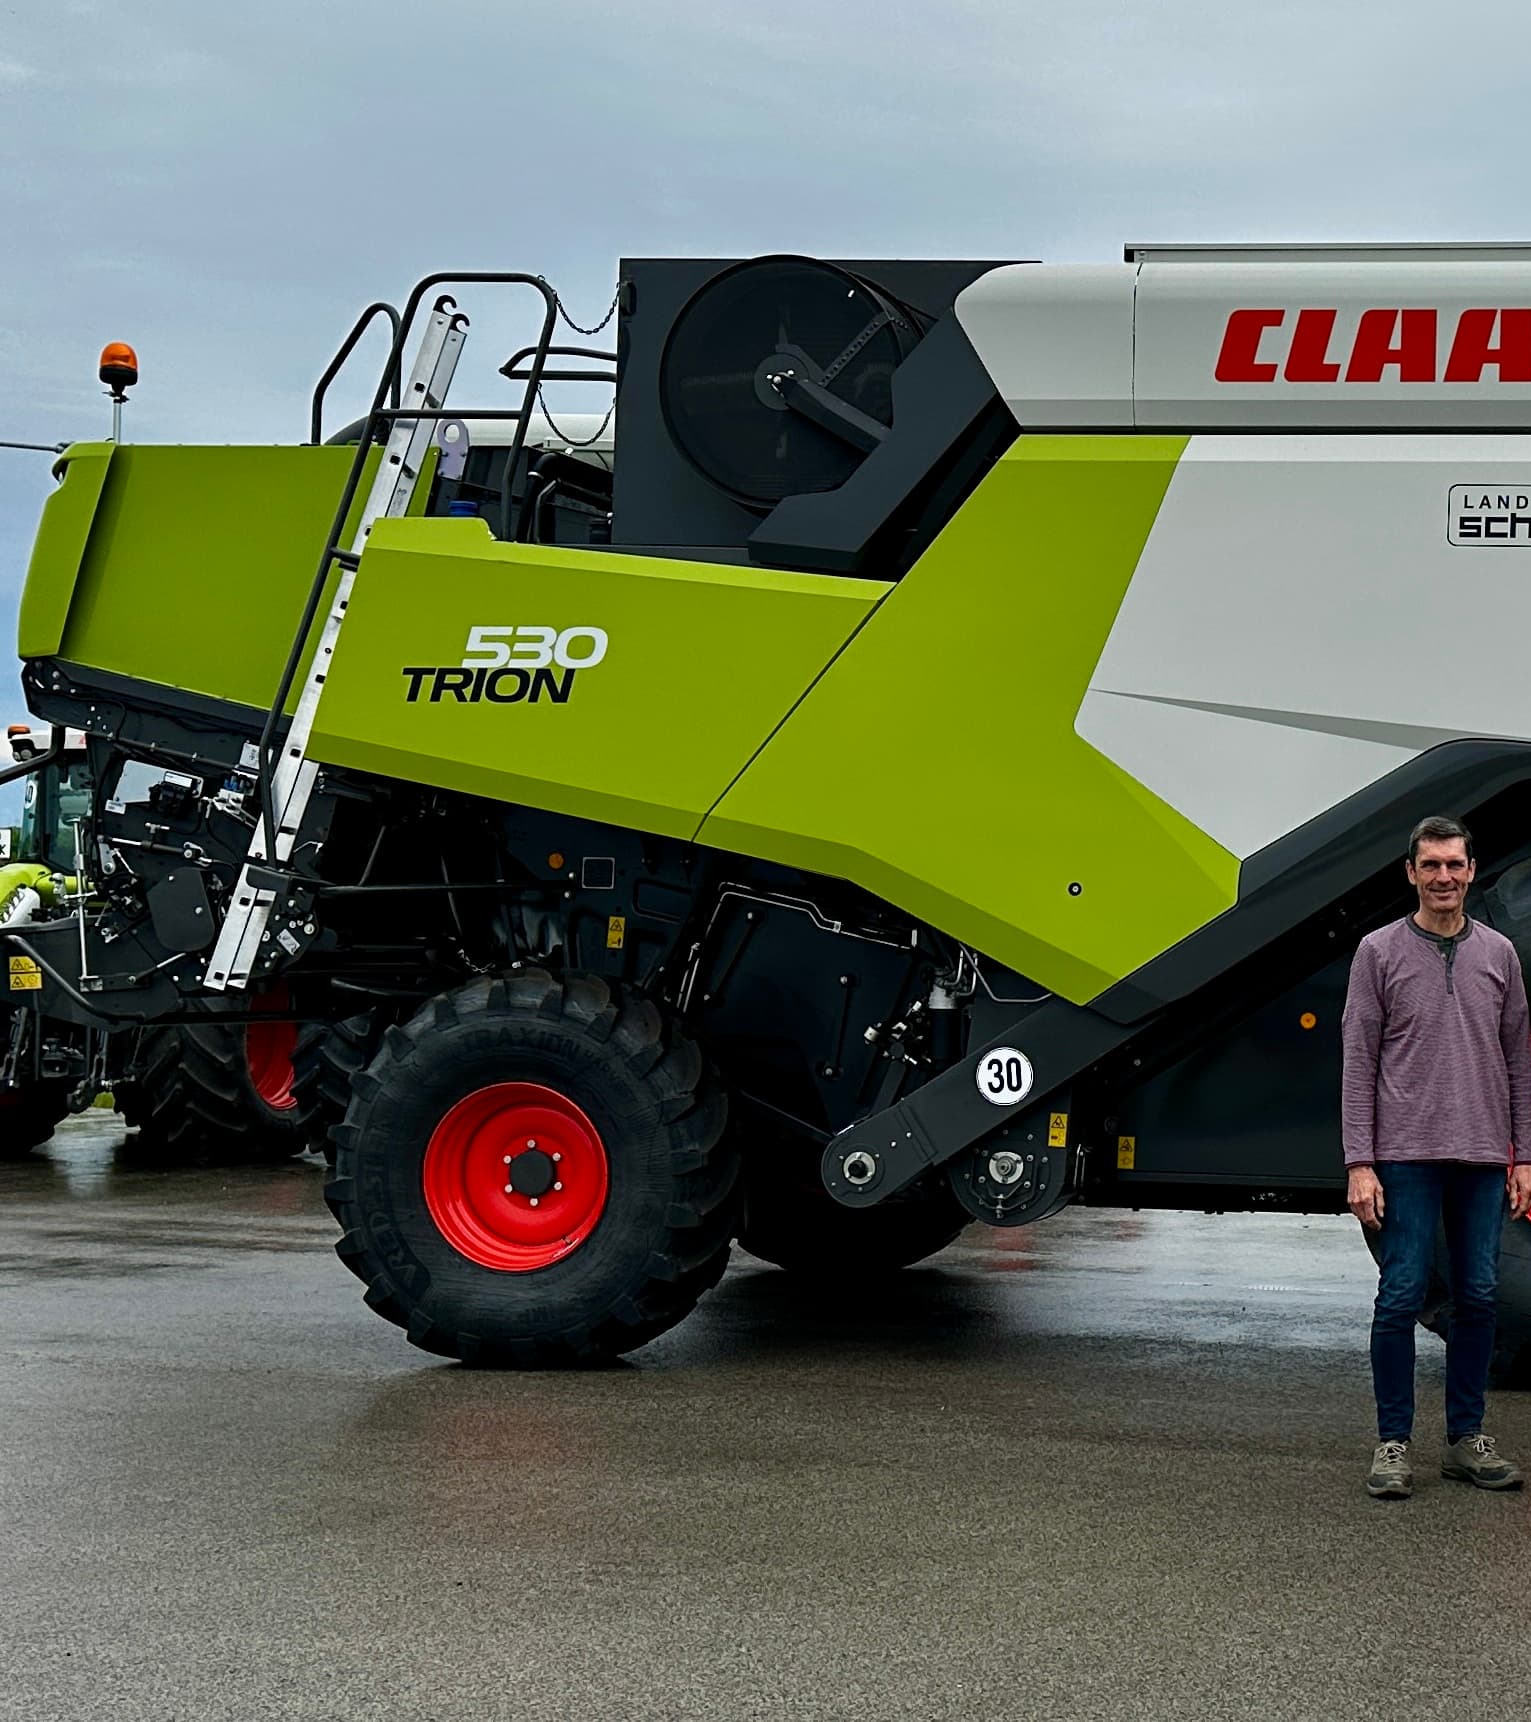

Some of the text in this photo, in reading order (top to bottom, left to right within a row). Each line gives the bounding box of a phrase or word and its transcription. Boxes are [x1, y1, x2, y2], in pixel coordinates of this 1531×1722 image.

[461, 626, 609, 669] 530
[402, 667, 577, 704] TRION
[987, 1057, 1023, 1094] 30
